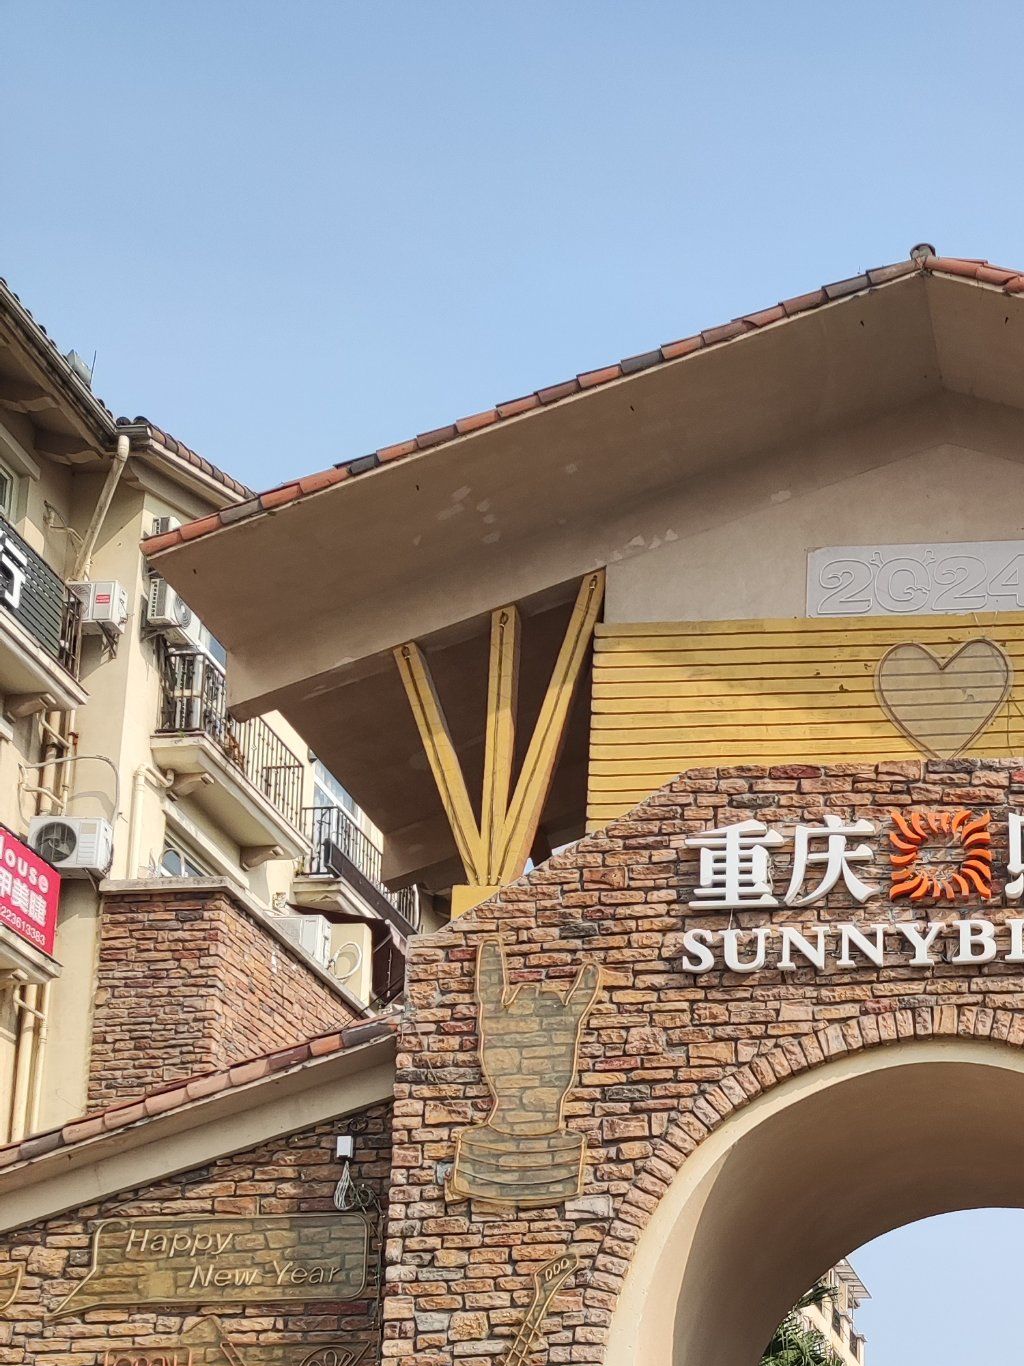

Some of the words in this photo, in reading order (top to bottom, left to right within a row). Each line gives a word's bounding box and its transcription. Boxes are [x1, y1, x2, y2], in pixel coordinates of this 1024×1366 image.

[684, 813, 882, 911] 重庆
[125, 1229, 234, 1258] Happy
[189, 1264, 258, 1289] New
[272, 1260, 342, 1285] Year
